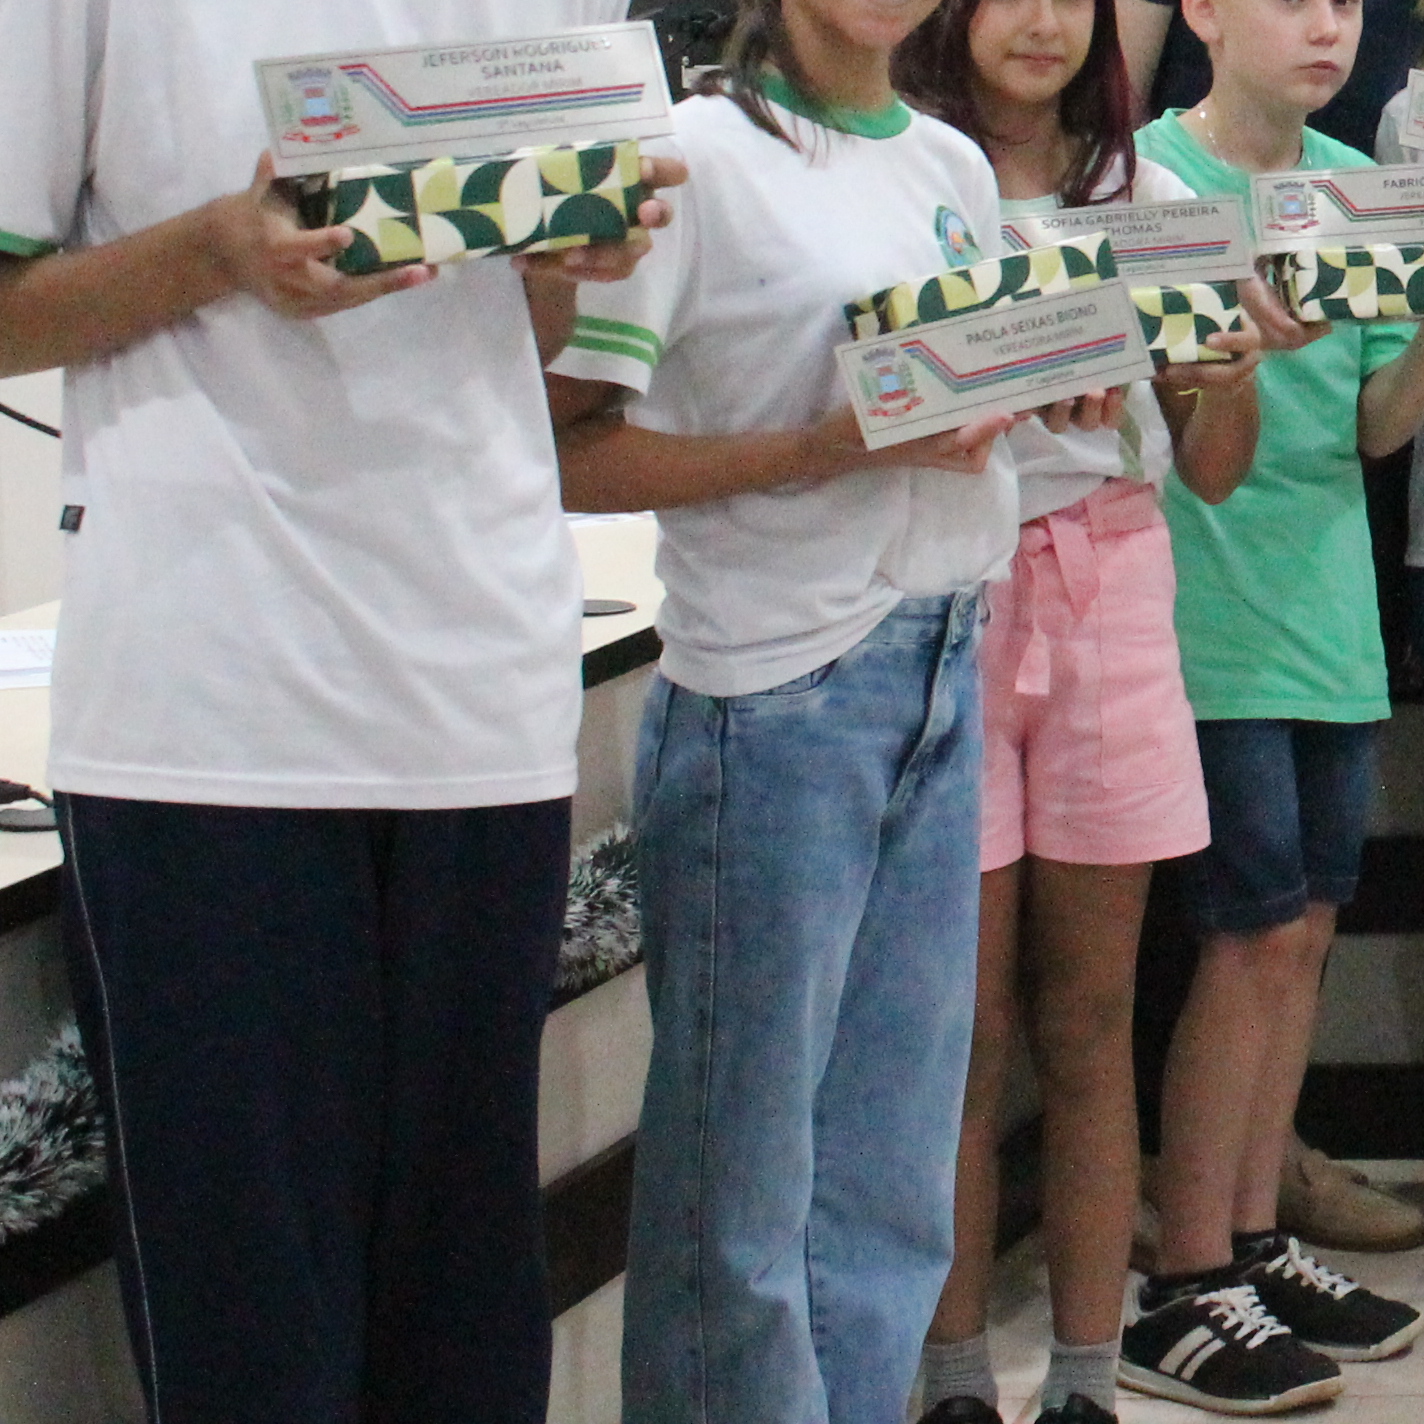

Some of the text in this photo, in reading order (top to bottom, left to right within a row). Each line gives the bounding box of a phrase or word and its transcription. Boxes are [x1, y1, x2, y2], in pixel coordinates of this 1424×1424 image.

[423, 47, 509, 68] JEFERSON
[481, 59, 565, 79] SANTANA
[1042, 206, 1219, 230] SOFIA GABRIELLY PEREIRA
[1103, 223, 1163, 236] THOMAS
[966, 326, 1008, 345] PAOLA
[1010, 315, 1054, 334] SEIXAS
